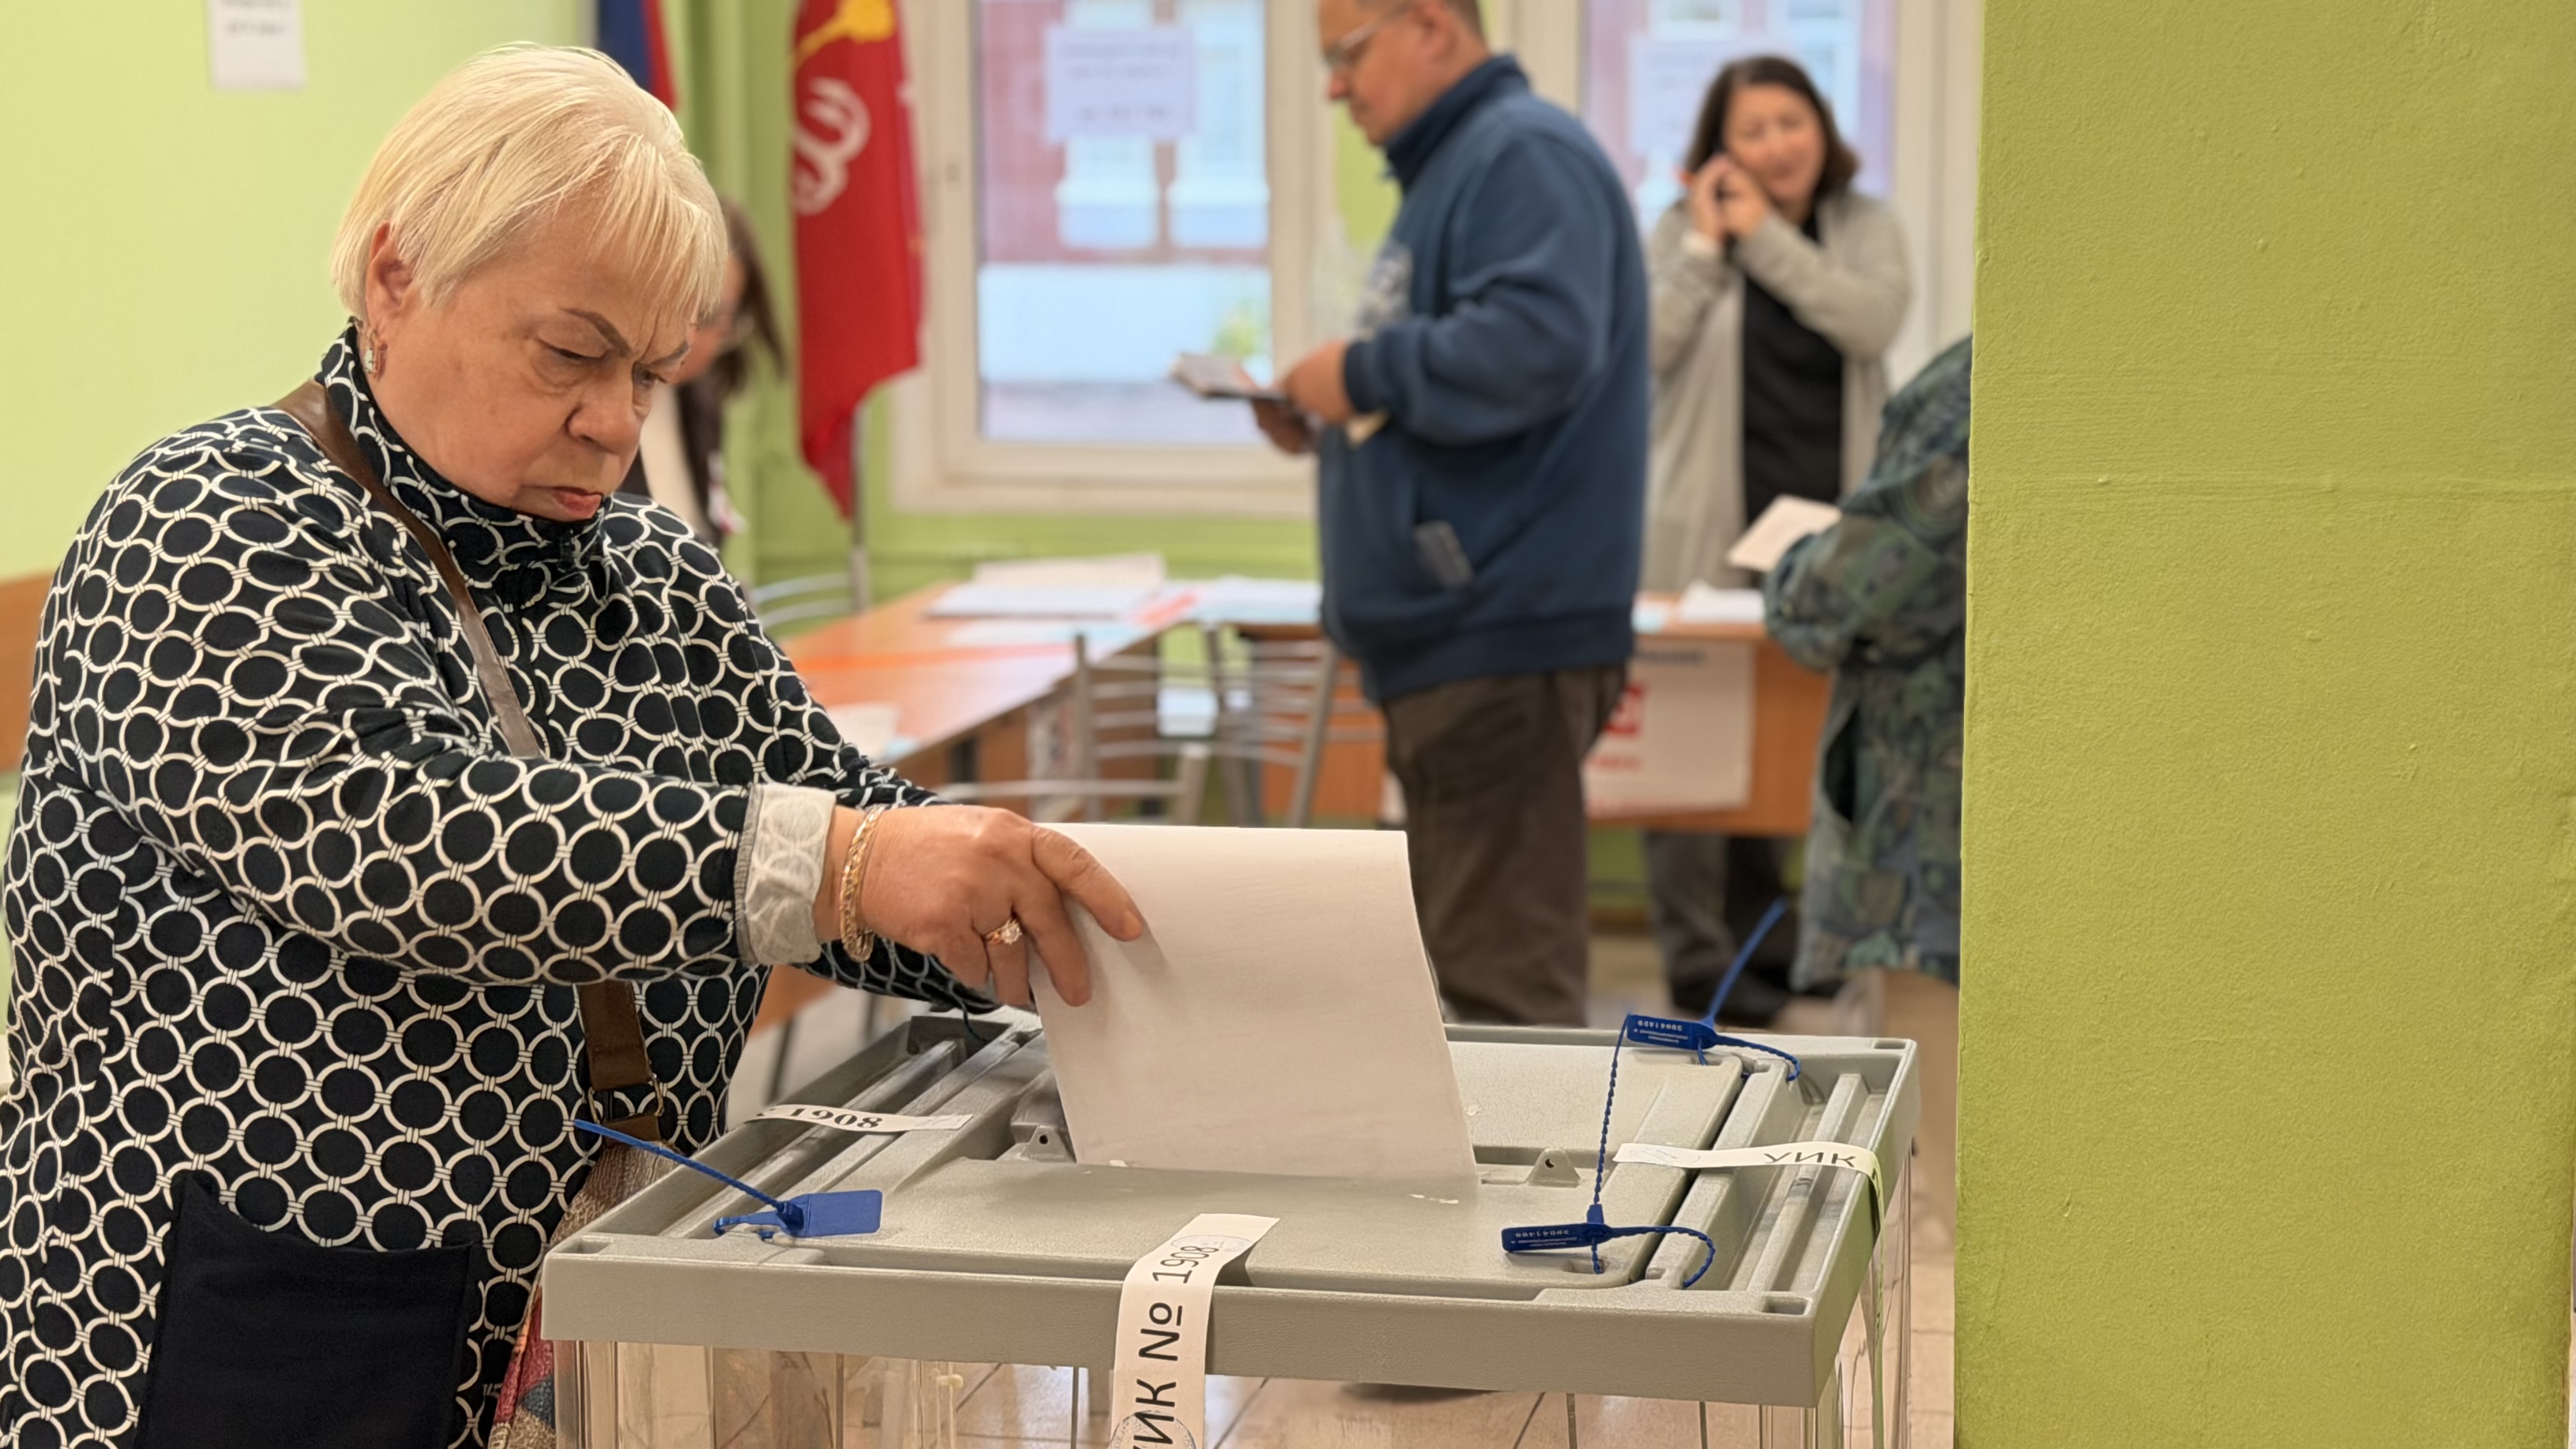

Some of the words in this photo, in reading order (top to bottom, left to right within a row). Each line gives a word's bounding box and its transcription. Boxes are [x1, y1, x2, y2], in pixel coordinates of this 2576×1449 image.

[789, 1108, 883, 1128] 1908
[1763, 1152, 1856, 1168] УИК
[1152, 1245, 1220, 1284] 1908
[1138, 1302, 1183, 1361] №
[1133, 1378, 1177, 1449] ИК
